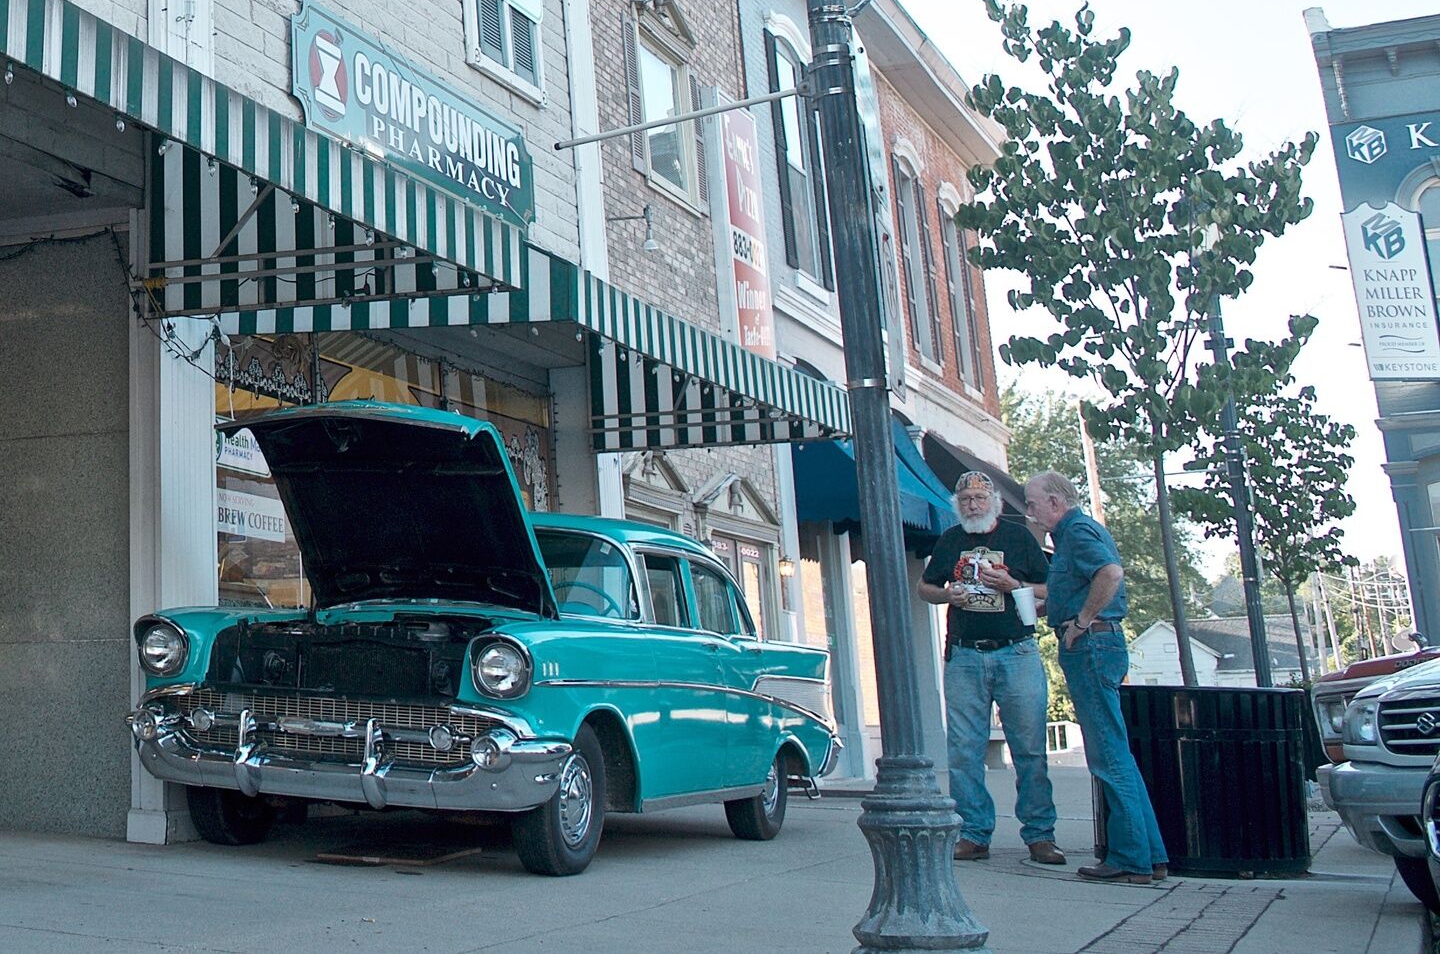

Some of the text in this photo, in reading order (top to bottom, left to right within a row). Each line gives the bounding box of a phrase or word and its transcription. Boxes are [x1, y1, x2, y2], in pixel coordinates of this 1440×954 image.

[353, 51, 521, 189] COMPOUNDING
[373, 114, 511, 208] PHARMACY
[1363, 268, 1417, 282] KNAPP
[1365, 286, 1424, 300] MILLER
[1366, 304, 1427, 318] BROWN
[1369, 321, 1428, 329] INSURANCE
[1385, 362, 1438, 372] KEYSTONE
[224, 434, 250, 450] Health
[224, 446, 254, 461] PHARMACY
[218, 506, 284, 533] BREW COFFEE
